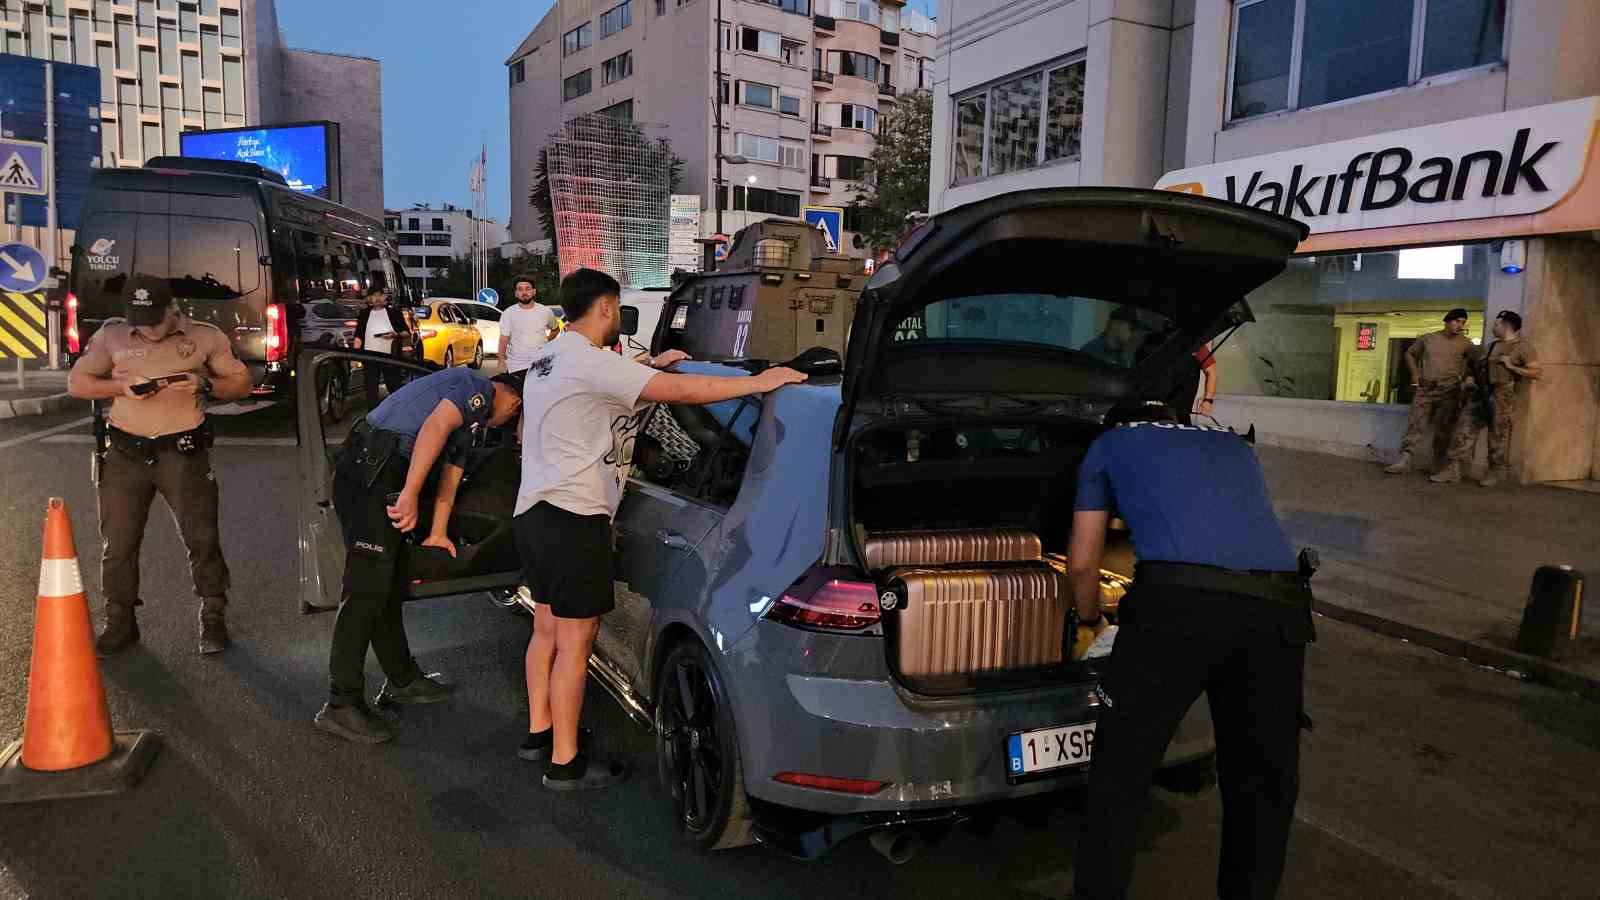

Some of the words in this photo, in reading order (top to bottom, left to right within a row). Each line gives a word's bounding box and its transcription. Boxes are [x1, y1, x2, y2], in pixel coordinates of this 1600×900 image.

[1225, 127, 1562, 218] VakıfBank
[87, 255, 120, 264] YOLCU
[733, 323, 749, 358] 82
[1012, 758, 1021, 771] B
